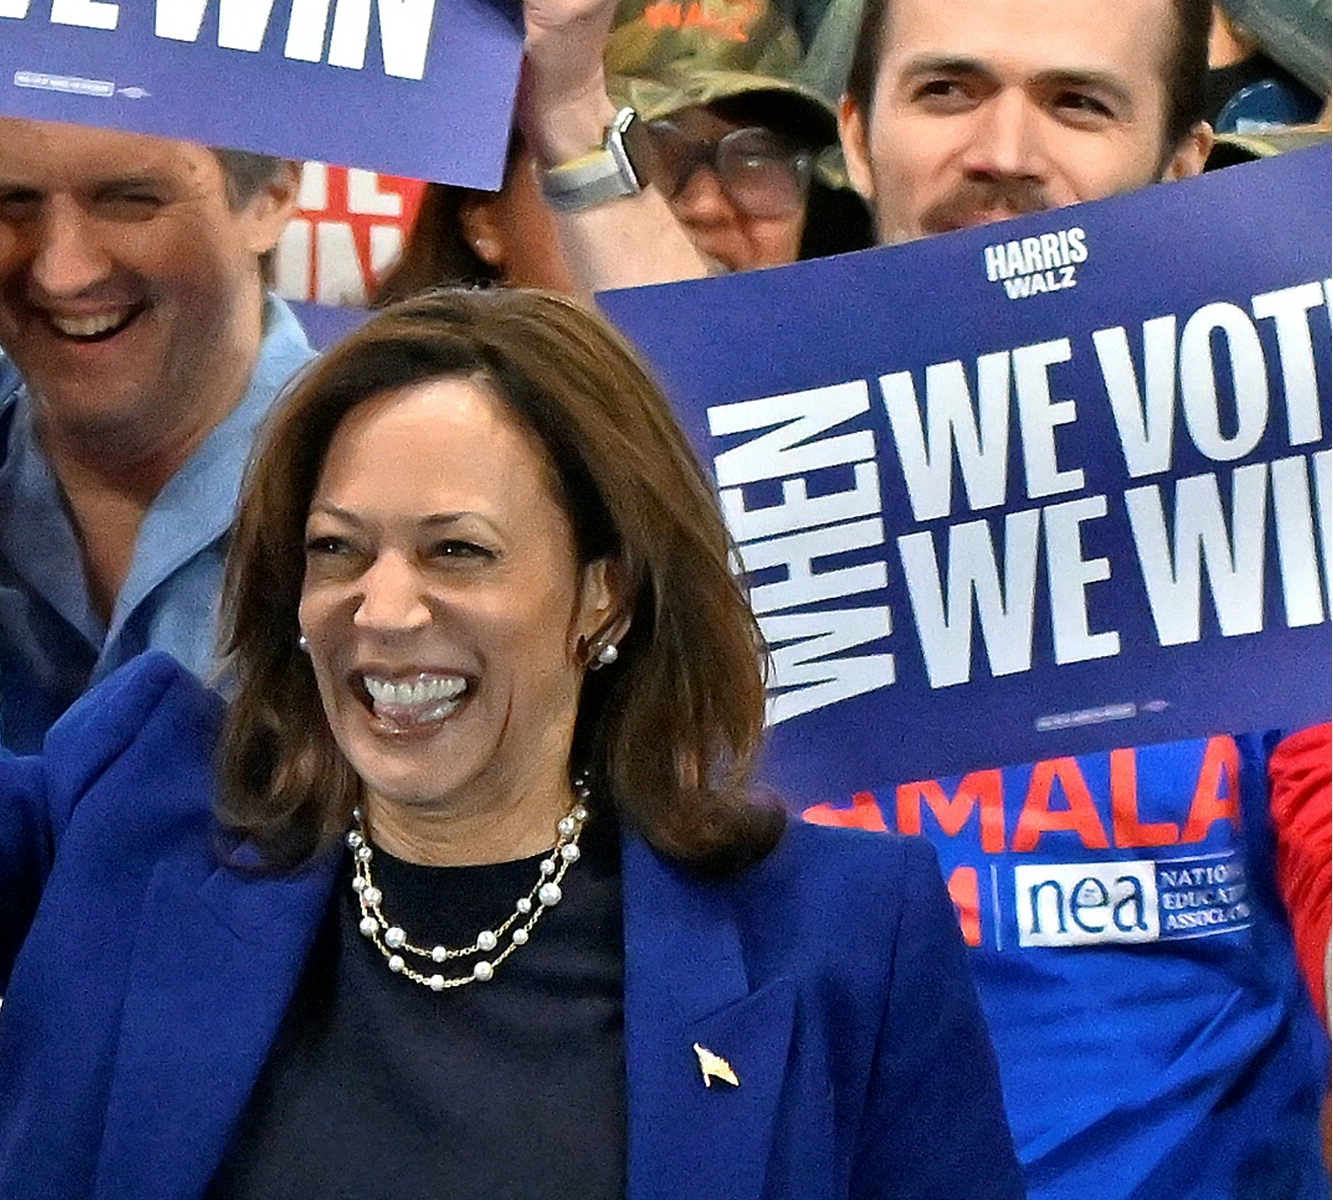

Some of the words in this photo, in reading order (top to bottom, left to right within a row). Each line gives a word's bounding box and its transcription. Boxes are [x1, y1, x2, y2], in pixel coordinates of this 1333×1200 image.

[984, 227, 1089, 282] HARRIS
[1004, 265, 1078, 300] WALZ
[878, 337, 1085, 522] WE
[1091, 278, 1332, 478] VOT
[707, 379, 895, 727] WHEN
[896, 495, 1121, 689] WE
[1029, 874, 1149, 934] nea
